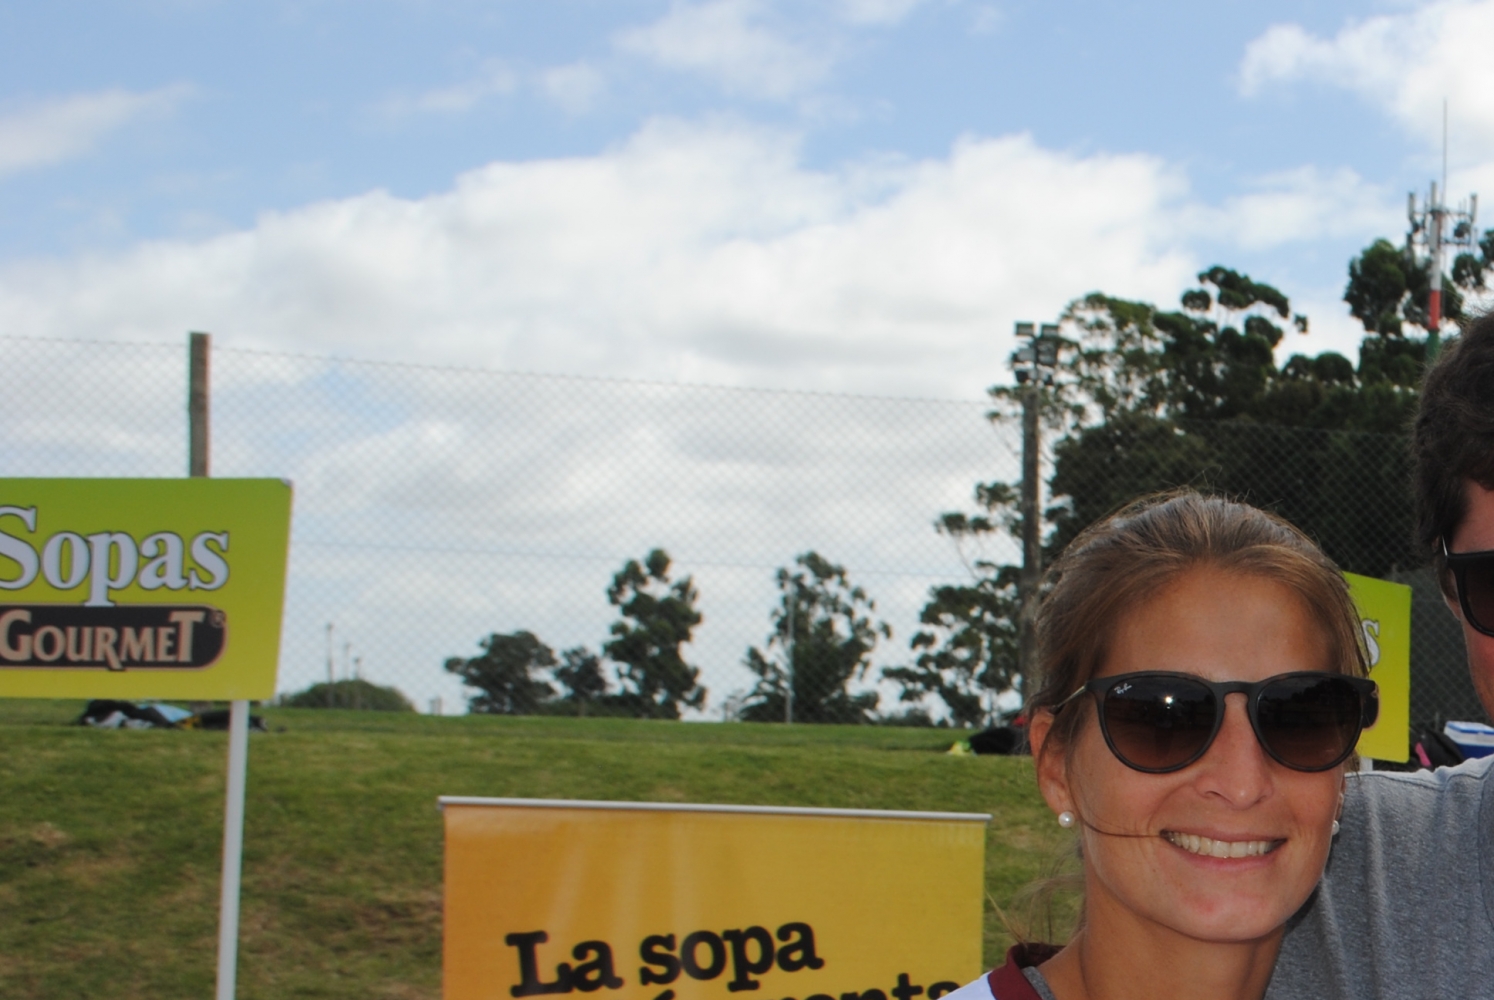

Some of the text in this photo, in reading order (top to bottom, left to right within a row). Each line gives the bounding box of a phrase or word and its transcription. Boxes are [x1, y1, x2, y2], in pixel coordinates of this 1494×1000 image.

[0, 505, 229, 606] Sopas
[0, 608, 205, 669] GOURMET
[505, 921, 825, 998] La sopa
